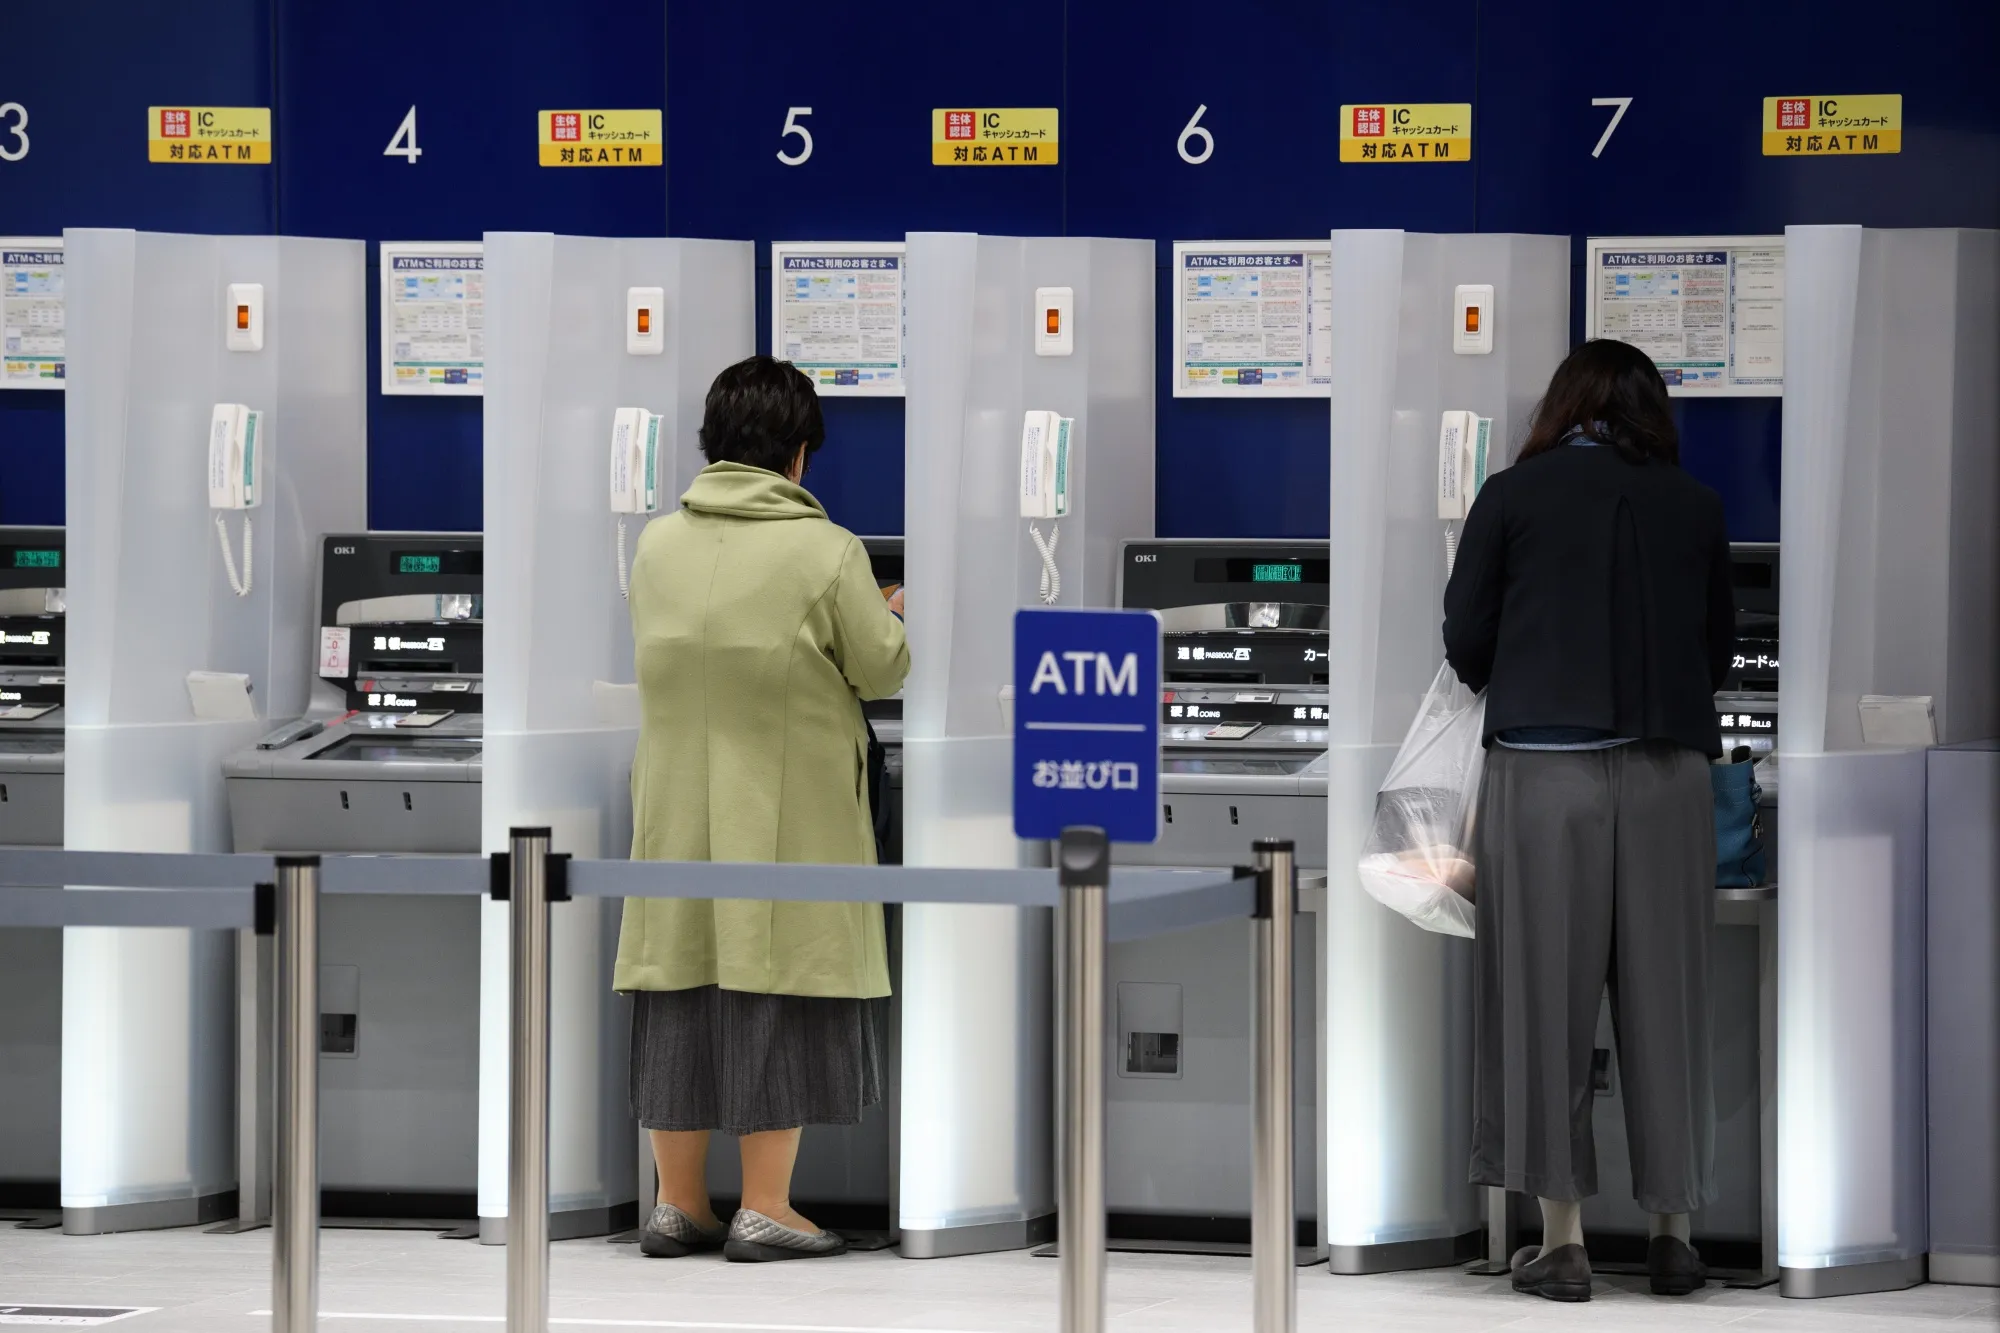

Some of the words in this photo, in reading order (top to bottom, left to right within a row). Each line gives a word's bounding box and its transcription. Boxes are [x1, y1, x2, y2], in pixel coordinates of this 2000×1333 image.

[1781, 101, 1806, 113] 生体
[1818, 100, 1838, 117] IC
[165, 111, 187, 123] 生体
[197, 112, 214, 127] IC
[555, 115, 577, 127] 生体
[949, 113, 972, 125] 生体
[982, 113, 1000, 128] IC
[1357, 109, 1381, 121] 生体
[1392, 108, 1411, 125] IC
[1781, 114, 1806, 127] 認証
[588, 114, 605, 130] IC
[1818, 116, 1889, 127] キャッシュカード
[0, 102, 30, 162] 3
[165, 124, 187, 136] 認証
[197, 127, 260, 138] キャッシュカード
[555, 128, 577, 139] 認証
[949, 126, 972, 138] 認証
[982, 129, 1047, 139] キャッシュカード
[1176, 103, 1215, 165] 6
[1357, 122, 1381, 134] 認証
[1392, 125, 1459, 135] キャッシュカード
[1591, 97, 1634, 159] 7
[383, 105, 423, 164] 4
[588, 131, 651, 140] キャッシュカード
[776, 106, 814, 166] 5
[8, 254, 64, 264] ATMをご利用
[1190, 256, 1299, 266] ATMをご利用のお客さまへ
[1607, 254, 1722, 264] ATMをご利用のお客さまへ
[333, 546, 355, 555] OKI
[1134, 554, 1158, 563] OKI
[1303, 648, 1330, 662] カー
[1029, 650, 1138, 697] ATM
[1751, 720, 1772, 728] BILLS
[1032, 759, 1139, 790] お並び口
